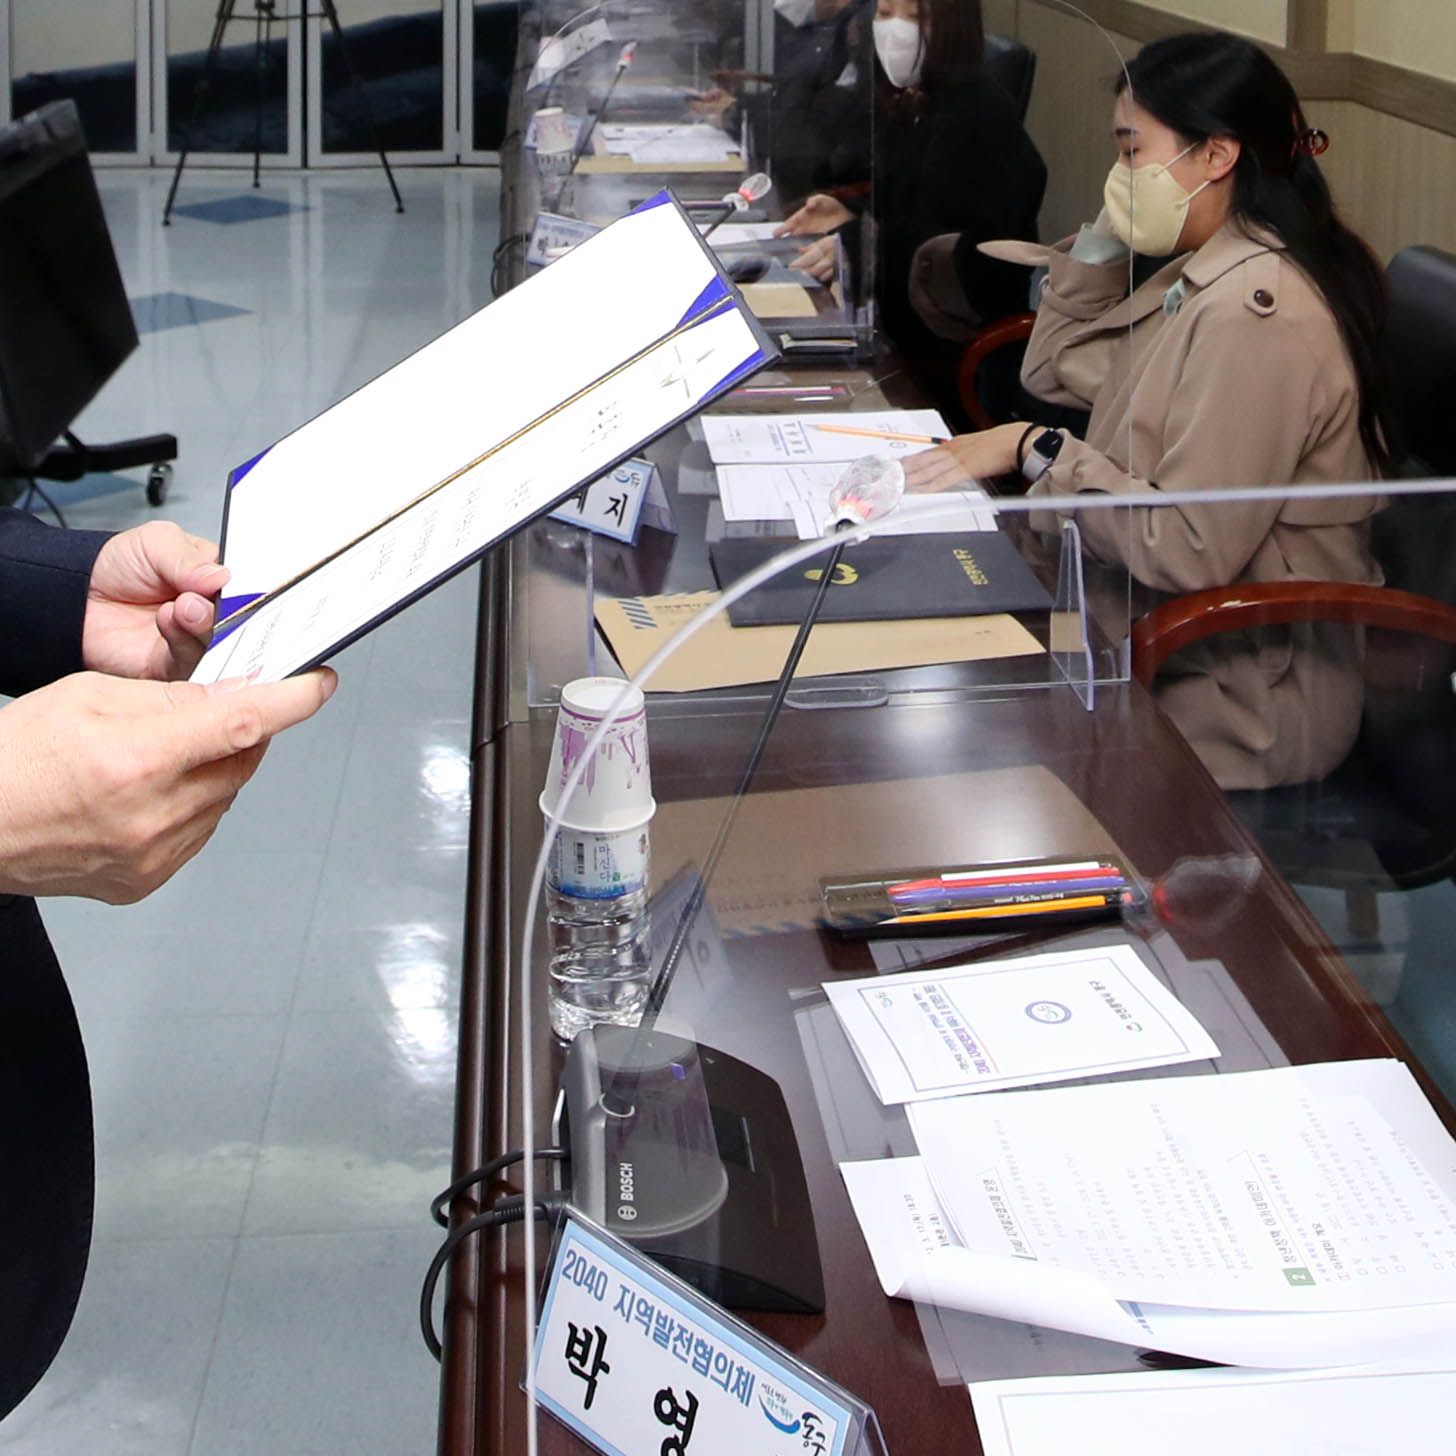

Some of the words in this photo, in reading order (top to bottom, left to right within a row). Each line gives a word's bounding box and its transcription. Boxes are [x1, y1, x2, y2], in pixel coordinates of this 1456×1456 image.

[602, 492, 630, 529] 지
[620, 1162, 634, 1201] BOSCH
[1239, 1180, 1283, 1226] 아카데미(안)
[1266, 1230, 1301, 1263] 청년정책
[1316, 1239, 1346, 1269] 아카데미
[562, 1248, 608, 1302] 2040
[613, 1284, 755, 1408] 지역발전협의체
[565, 1321, 610, 1410] 박
